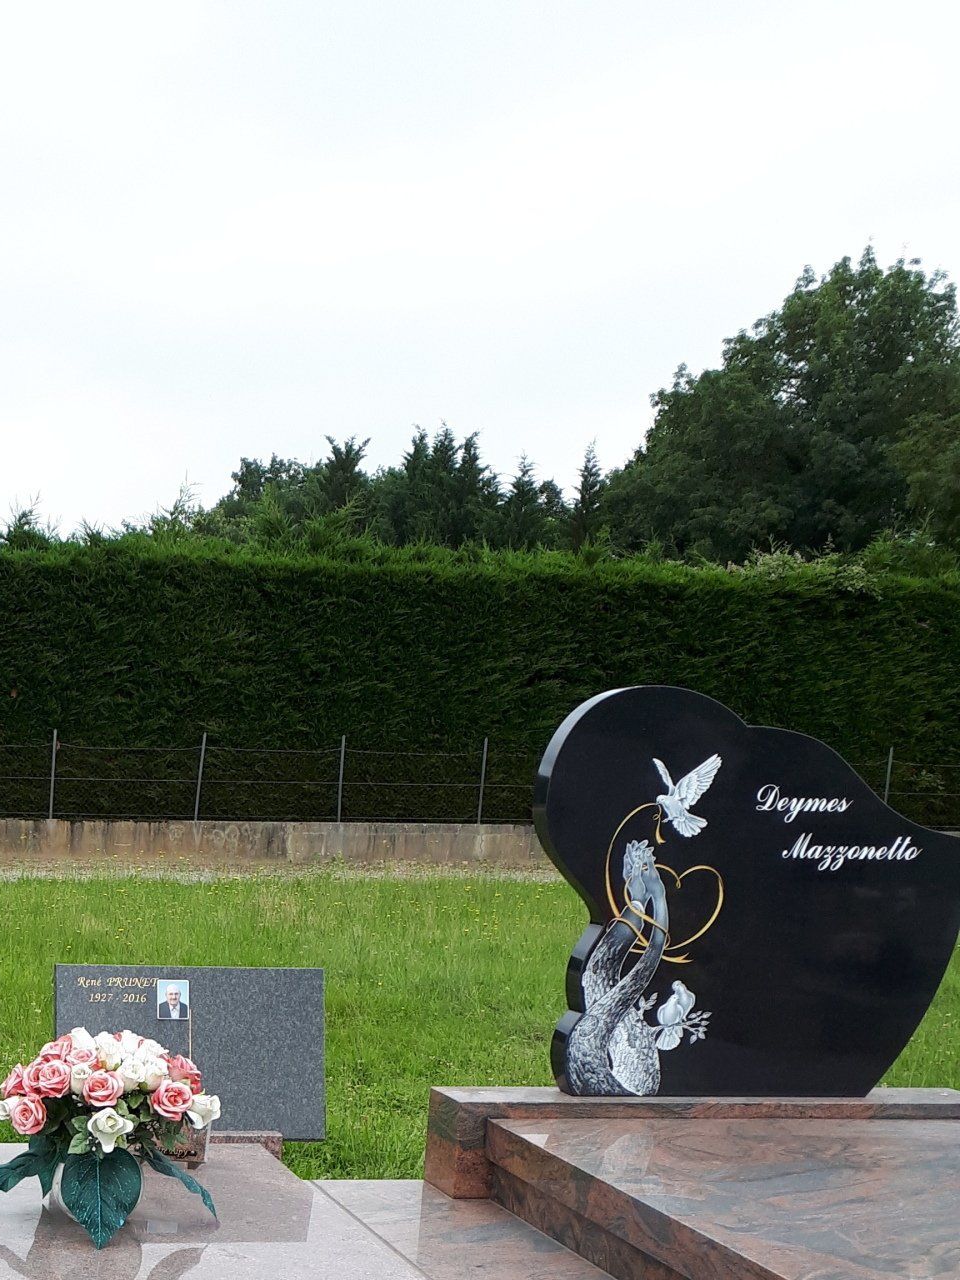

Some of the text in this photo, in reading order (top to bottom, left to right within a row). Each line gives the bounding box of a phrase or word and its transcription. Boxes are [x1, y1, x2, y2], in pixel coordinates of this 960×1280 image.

[755, 783, 854, 824] Deymes
[781, 832, 923, 871] Mazzonetto
[77, 976, 159, 988] René PRUNET
[88, 993, 114, 1003] 1927
[122, 993, 147, 1003] 2016
